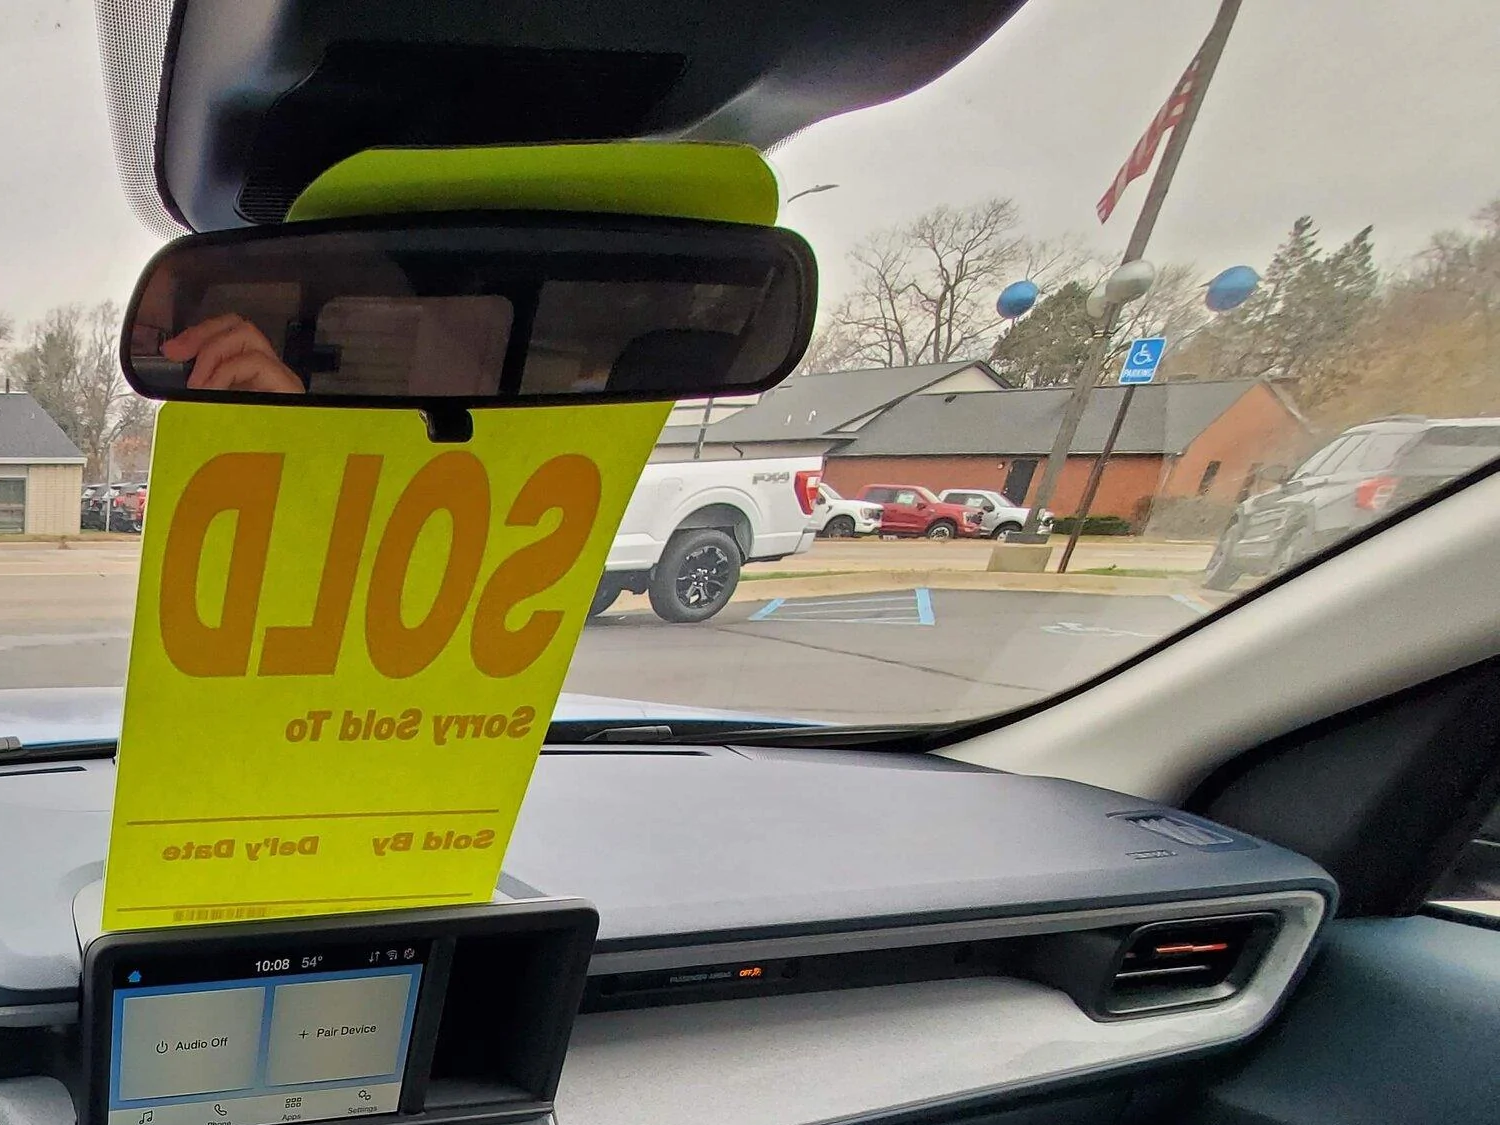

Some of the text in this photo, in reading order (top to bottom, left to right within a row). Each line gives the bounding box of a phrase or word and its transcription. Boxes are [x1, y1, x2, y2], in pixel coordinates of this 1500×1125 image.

[255, 958, 291, 973] 10:08
[739, 969, 752, 977] OFF
[317, 1023, 377, 1039] Pair Device
[175, 1036, 229, 1052] Audio Off
[348, 1105, 378, 1115] Settings
[282, 1113, 301, 1122] Apps
